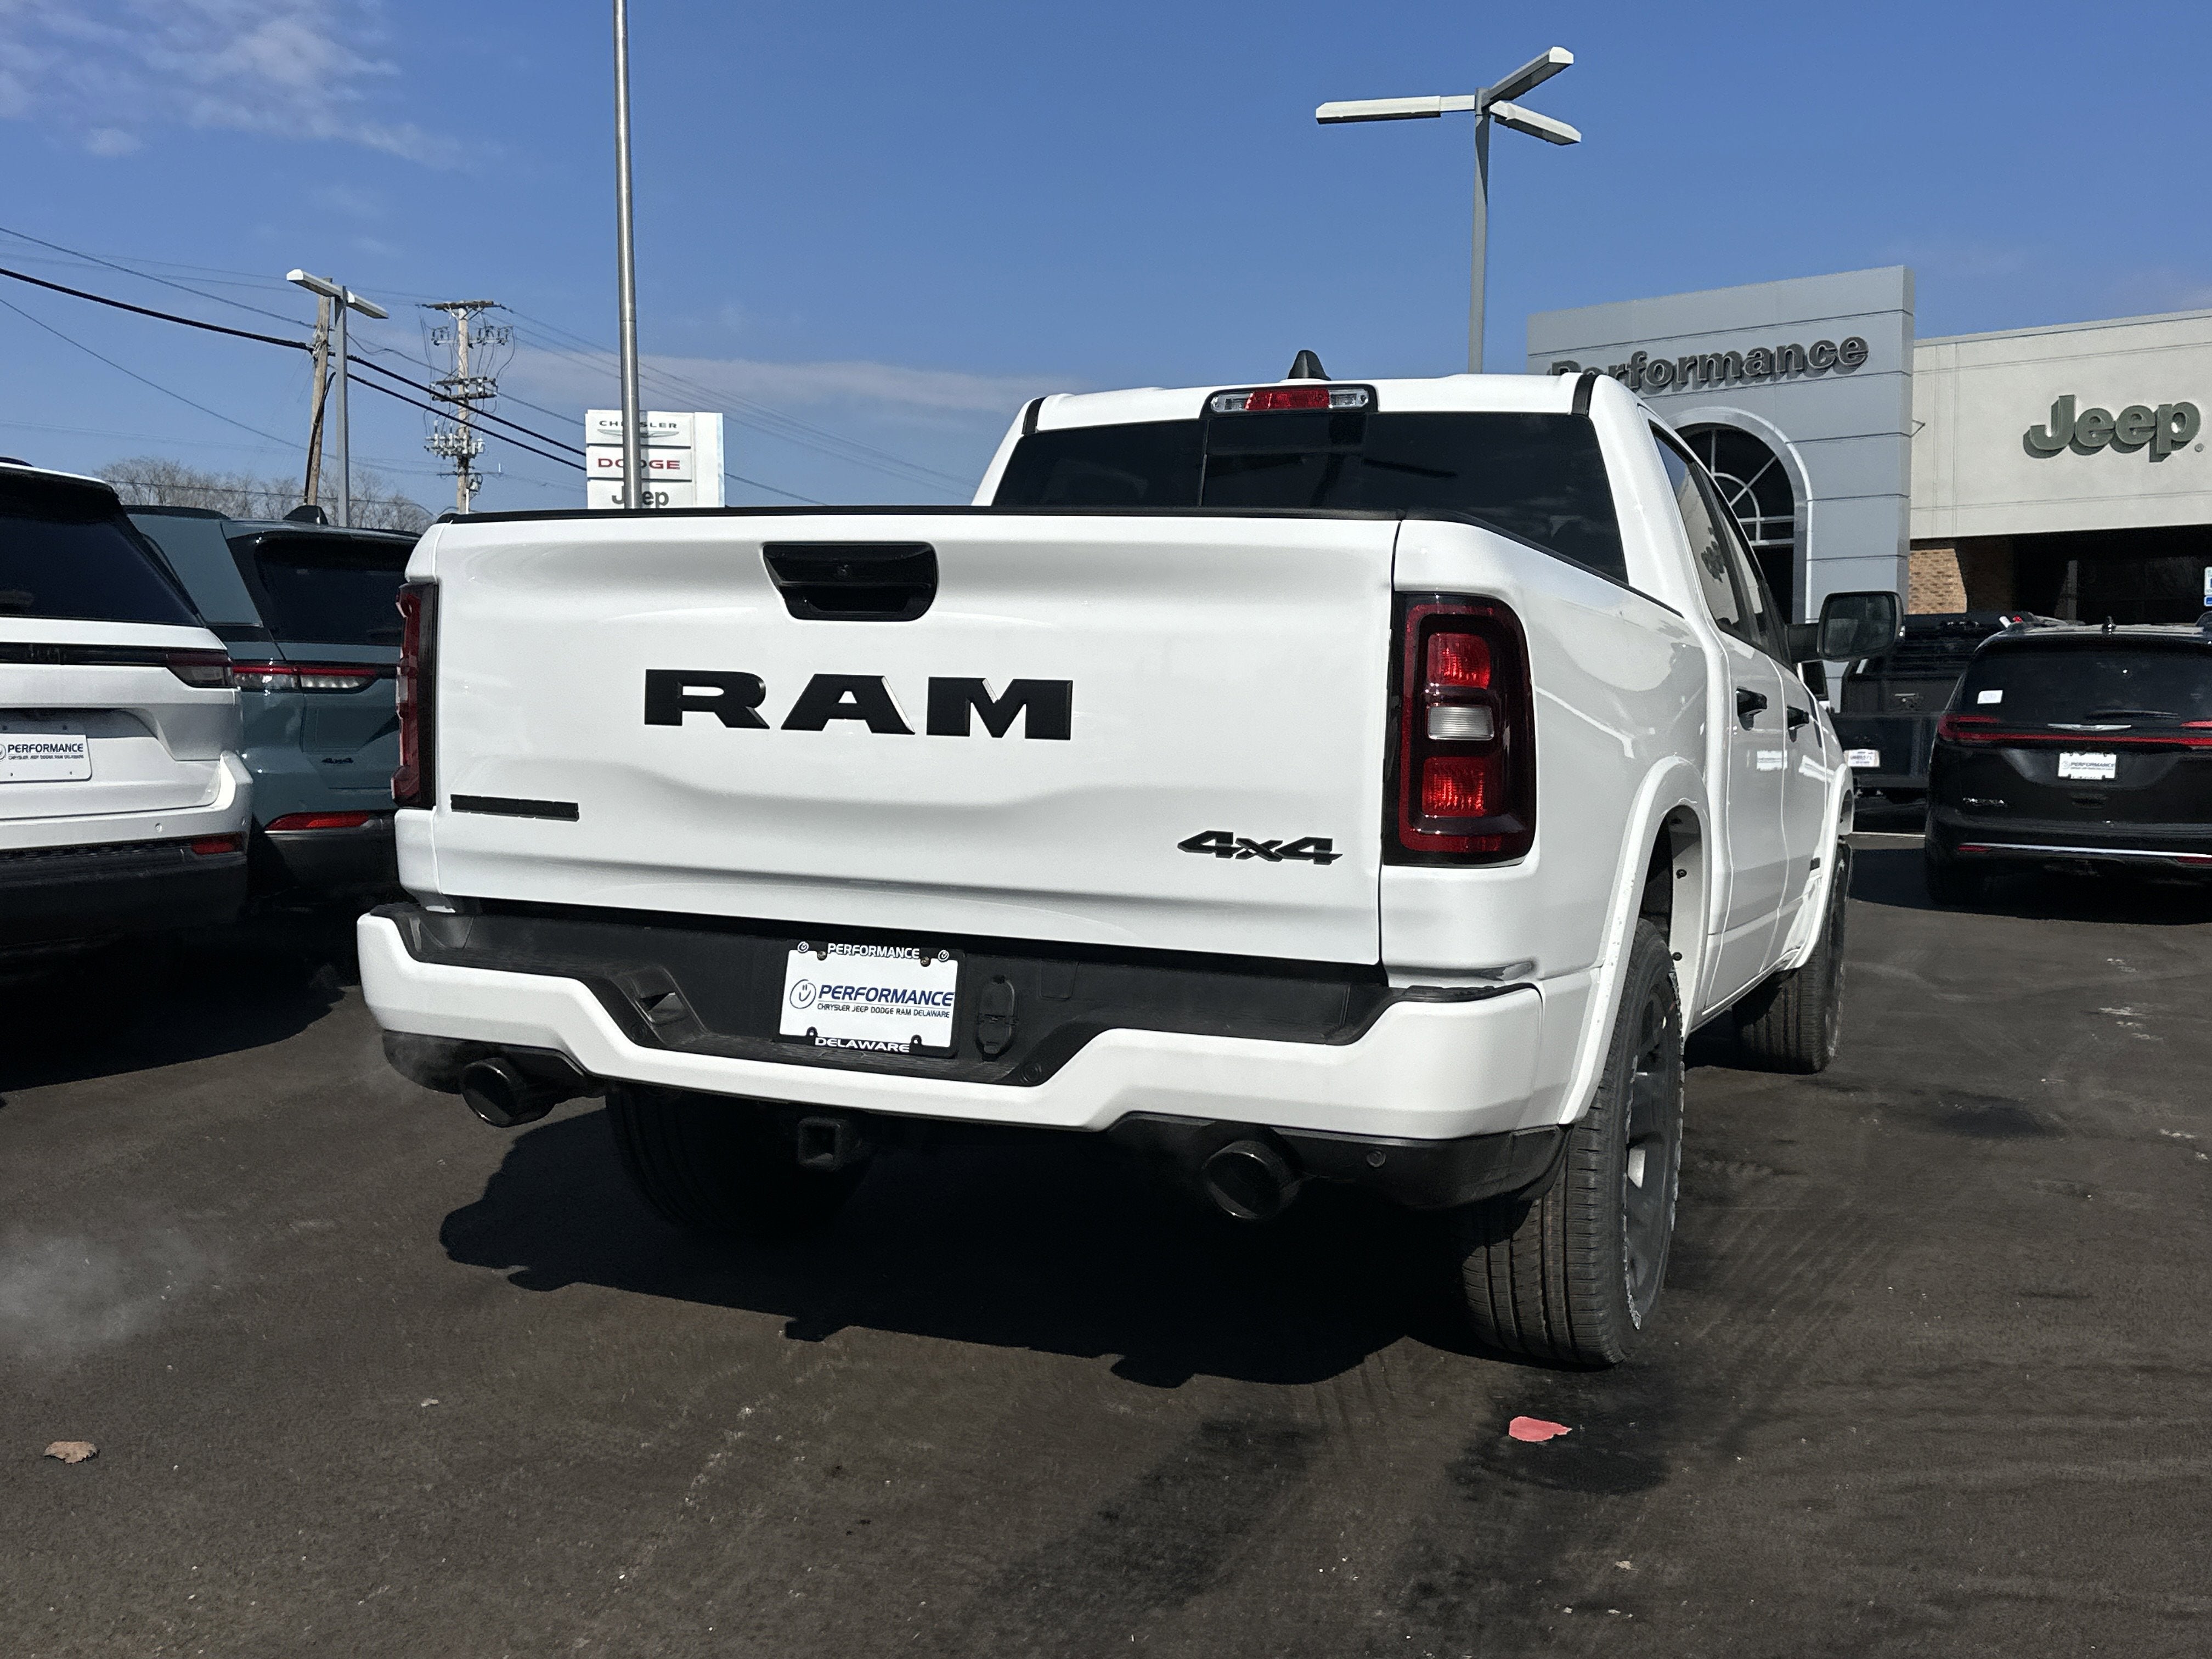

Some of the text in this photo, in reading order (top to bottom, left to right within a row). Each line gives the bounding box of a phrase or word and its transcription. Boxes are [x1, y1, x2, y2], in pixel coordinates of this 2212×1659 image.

[1550, 336, 1868, 388] rformance
[599, 420, 677, 428] CHSLER
[2024, 394, 2201, 462] Jeep
[612, 486, 669, 507] Jep
[644, 668, 1074, 741] RAM
[8, 743, 84, 753] PERFORMANCE
[1177, 830, 1343, 865] 4x4
[827, 943, 920, 960] PERFORMANCE
[819, 984, 955, 1006] PERFORMANCE
[817, 1003, 850, 1012] CHRYSLER
[913, 1009, 950, 1018] DELAWARE
[815, 1037, 910, 1053] DELAWARE
